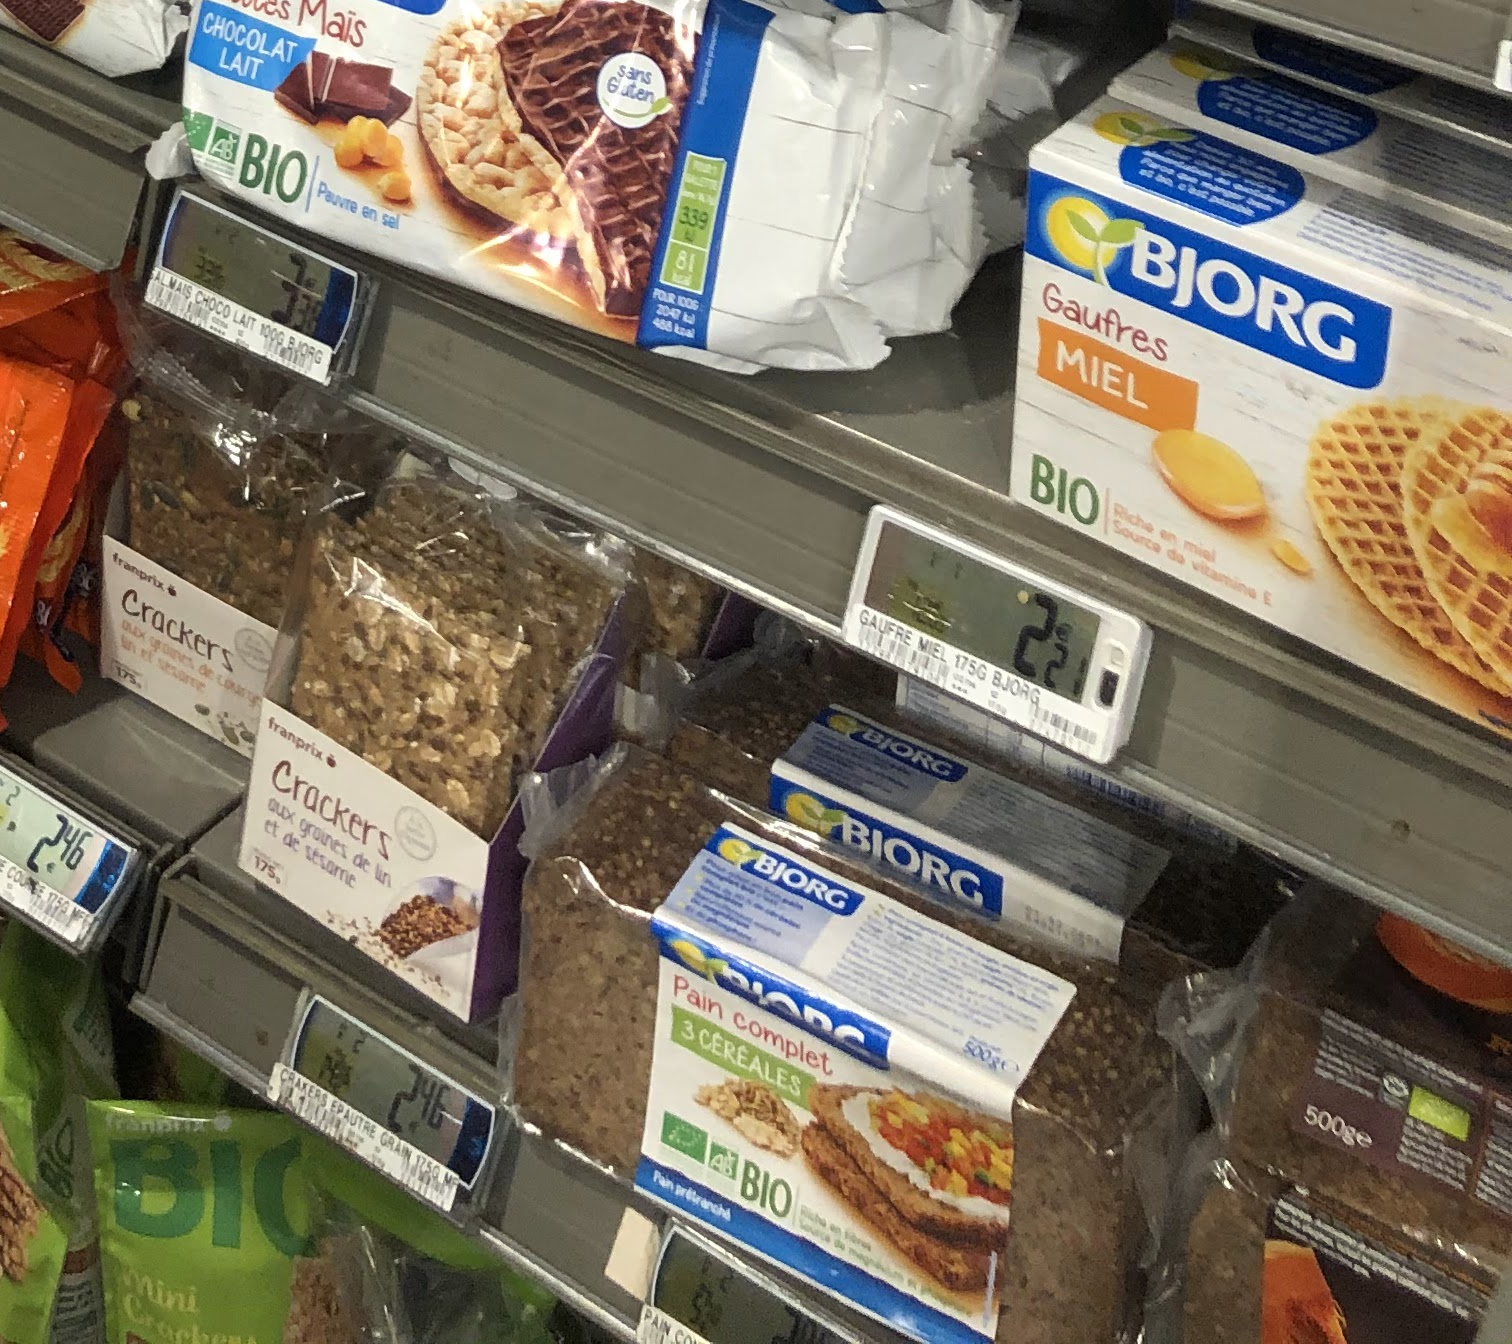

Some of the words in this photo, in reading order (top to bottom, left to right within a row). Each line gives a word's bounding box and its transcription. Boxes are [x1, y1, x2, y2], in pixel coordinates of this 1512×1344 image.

[202, 13, 299, 64] CHOCOLAT
[218, 46, 265, 80] LAIT
[615, 63, 653, 85] sans
[240, 132, 307, 206] BIO
[317, 179, 360, 216] Pauvre
[360, 198, 377, 219] en
[380, 209, 400, 231] sel
[195, 290, 231, 320] CHOCO
[232, 307, 258, 331] LAIT
[1041, 281, 1170, 364] Gaufres
[1130, 225, 1360, 364] BJORG
[1054, 338, 1149, 411] MIEL
[1029, 452, 1101, 526] BIO
[112, 552, 165, 594] franprix
[121, 588, 235, 673] Crackers
[859, 609, 912, 647] GAUFRE
[917, 632, 948, 664] MIEL
[954, 653, 987, 682] 175G
[991, 666, 1041, 706] BJORG
[267, 716, 324, 764] franprix
[271, 759, 394, 861] Crackers
[753, 850, 850, 913] BJORG
[672, 974, 724, 1024] Pain
[732, 1009, 834, 1077] complet
[680, 1017, 695, 1041] 3
[696, 1023, 804, 1100] CÉRÉALES
[739, 1162, 793, 1219] BIO
